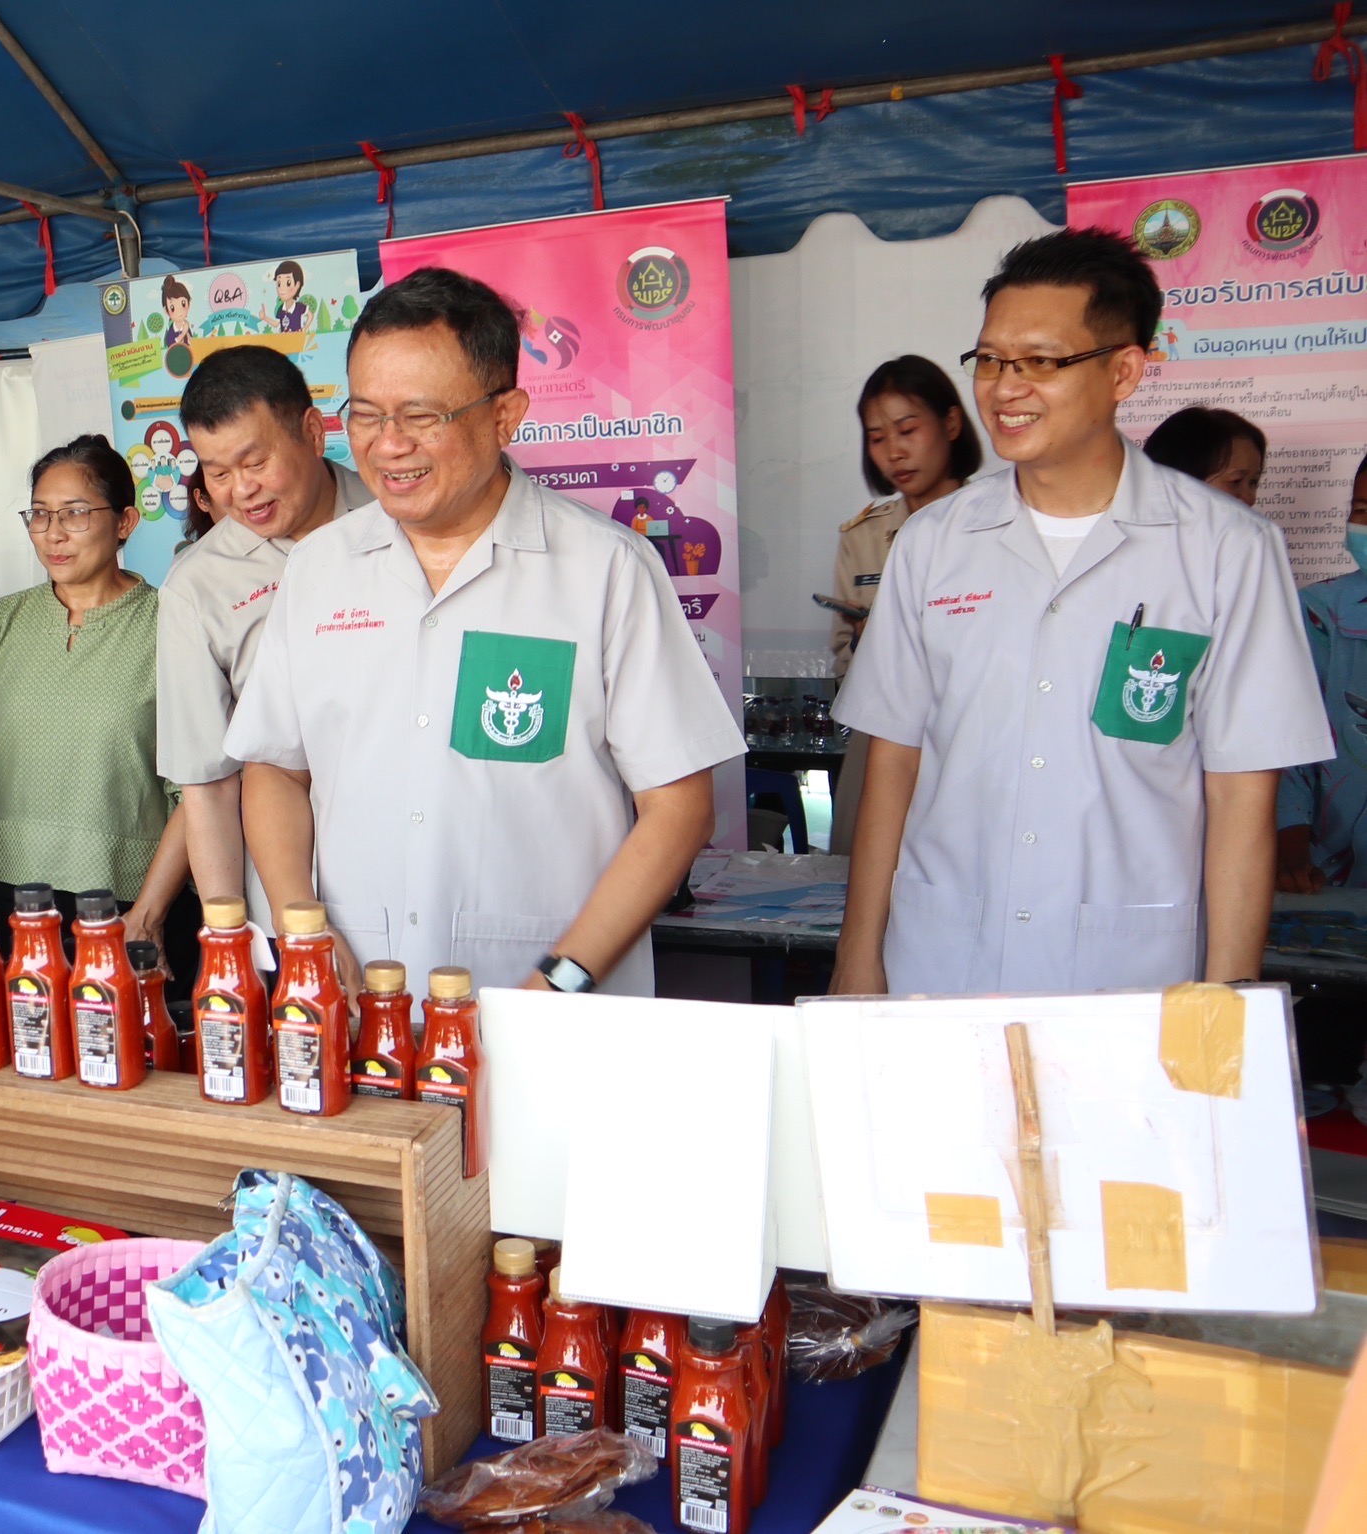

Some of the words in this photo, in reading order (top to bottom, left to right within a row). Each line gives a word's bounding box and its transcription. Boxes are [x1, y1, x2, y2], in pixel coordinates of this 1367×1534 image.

[213, 286, 244, 304] Q&A
[612, 300, 697, 332] กรมการพัฒนาชุมชน
[1193, 335, 1288, 357] เงินอุดหนุน
[1288, 511, 1311, 520] บาท
